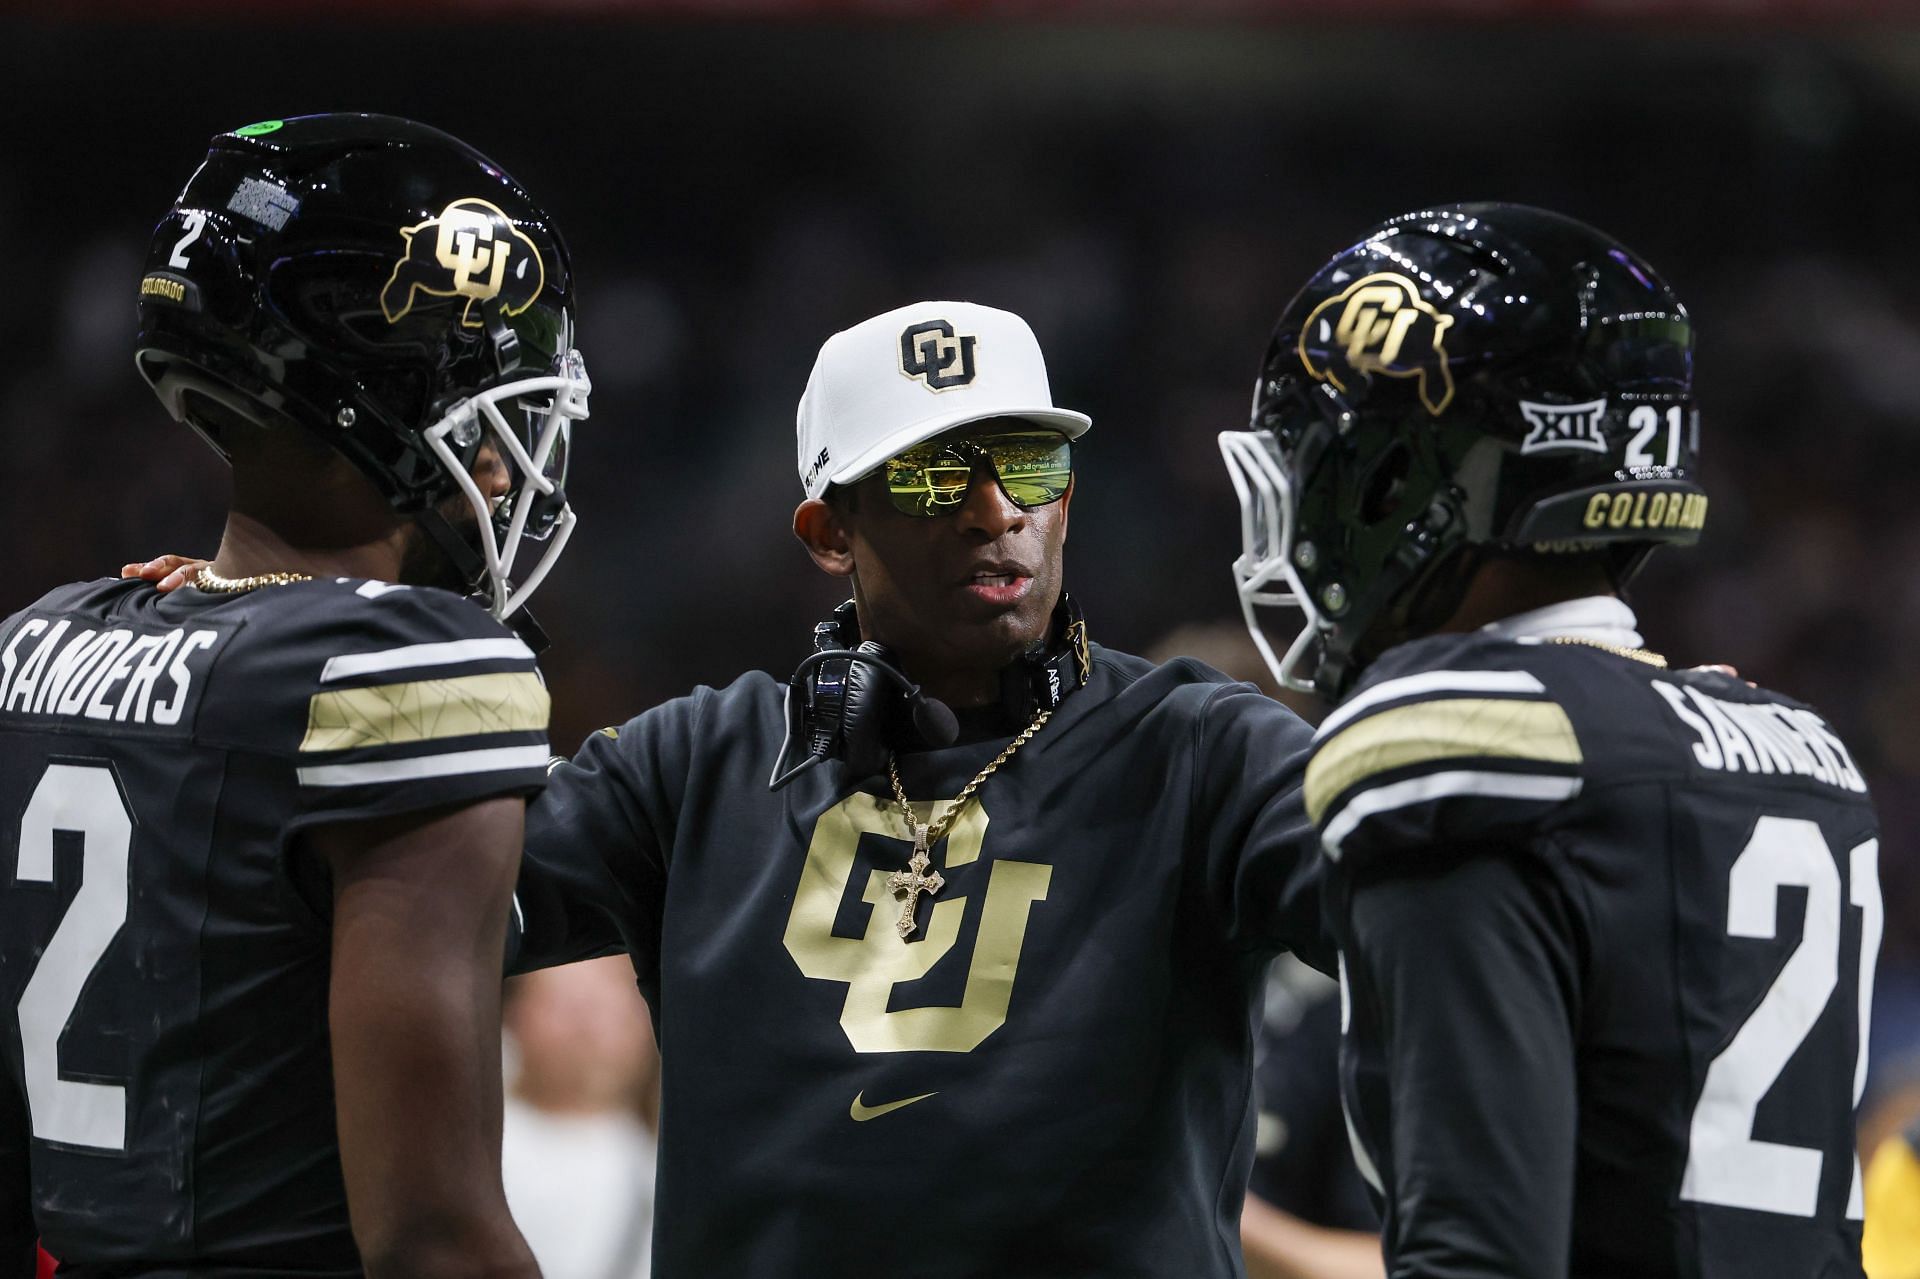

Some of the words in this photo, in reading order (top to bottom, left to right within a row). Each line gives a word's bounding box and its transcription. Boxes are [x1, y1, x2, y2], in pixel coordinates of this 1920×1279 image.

[168, 211, 207, 270] 2
[141, 277, 185, 302] COLORADO
[899, 318, 978, 391] CU
[1526, 406, 1598, 447] XII
[1623, 405, 1683, 470] 21
[1583, 492, 1708, 530] COLORAD
[0, 618, 218, 725] SANDERS
[1651, 679, 1867, 793] SANDERS
[16, 764, 134, 1150] 2
[783, 790, 1052, 1053] CU
[1680, 816, 1884, 1220] 21
